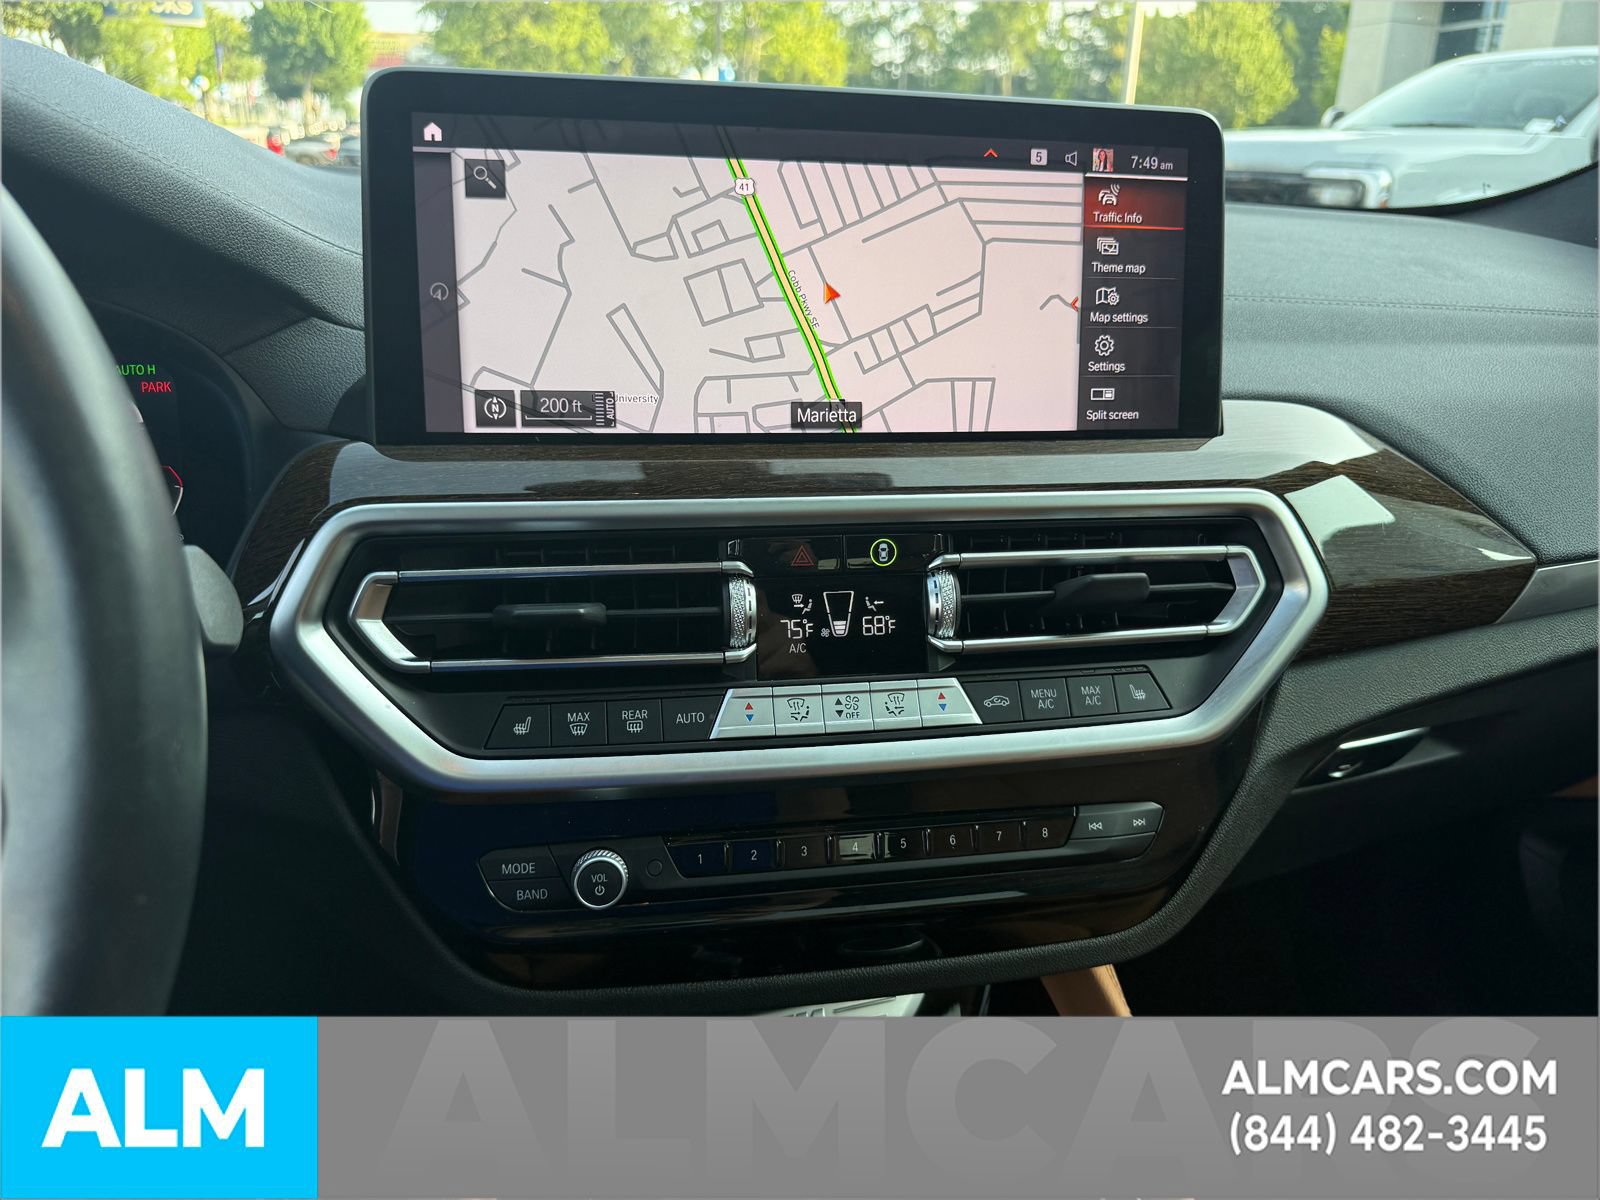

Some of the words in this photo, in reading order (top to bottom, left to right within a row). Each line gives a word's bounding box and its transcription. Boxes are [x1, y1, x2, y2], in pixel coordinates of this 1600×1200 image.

[1035, 151, 1042, 163] 5
[1131, 156, 1158, 170] 7:49
[1160, 162, 1174, 170] am
[739, 182, 748, 191] 41
[1093, 212, 1122, 223] Traffic
[1124, 212, 1142, 224] Info
[1092, 262, 1124, 272] Theme
[1126, 264, 1146, 274] map
[787, 269, 802, 294] Cobb
[800, 293, 813, 316] Pkwy
[810, 316, 820, 329] SE
[1090, 312, 1110, 324] Map
[1112, 312, 1148, 324] settings
[147, 364, 156, 374] H
[1088, 361, 1126, 372] Settings
[141, 382, 172, 392] PARK
[540, 398, 568, 413] 200
[572, 400, 582, 413] ft
[606, 397, 614, 420] AUTO
[797, 408, 857, 422] Marietta
[1086, 410, 1107, 421] Split
[1108, 411, 1138, 420] screen
[788, 643, 806, 654] A/C
[1031, 688, 1056, 699] MENU
[1081, 685, 1101, 696] MAX
[1038, 699, 1054, 710] A/C
[1085, 694, 1102, 706] A/C
[567, 712, 590, 722] MAX
[622, 710, 648, 720] REAR
[676, 712, 705, 724] AUTO
[996, 831, 1002, 842] 7
[1042, 827, 1048, 838] 8
[900, 838, 906, 849] 5
[950, 834, 956, 846] 6
[801, 846, 808, 857] 3
[852, 841, 858, 852] 4
[697, 853, 703, 864] 1
[751, 850, 758, 861] 2
[502, 862, 536, 875] MODE
[591, 873, 608, 883] VOL
[516, 888, 548, 901] BAND
